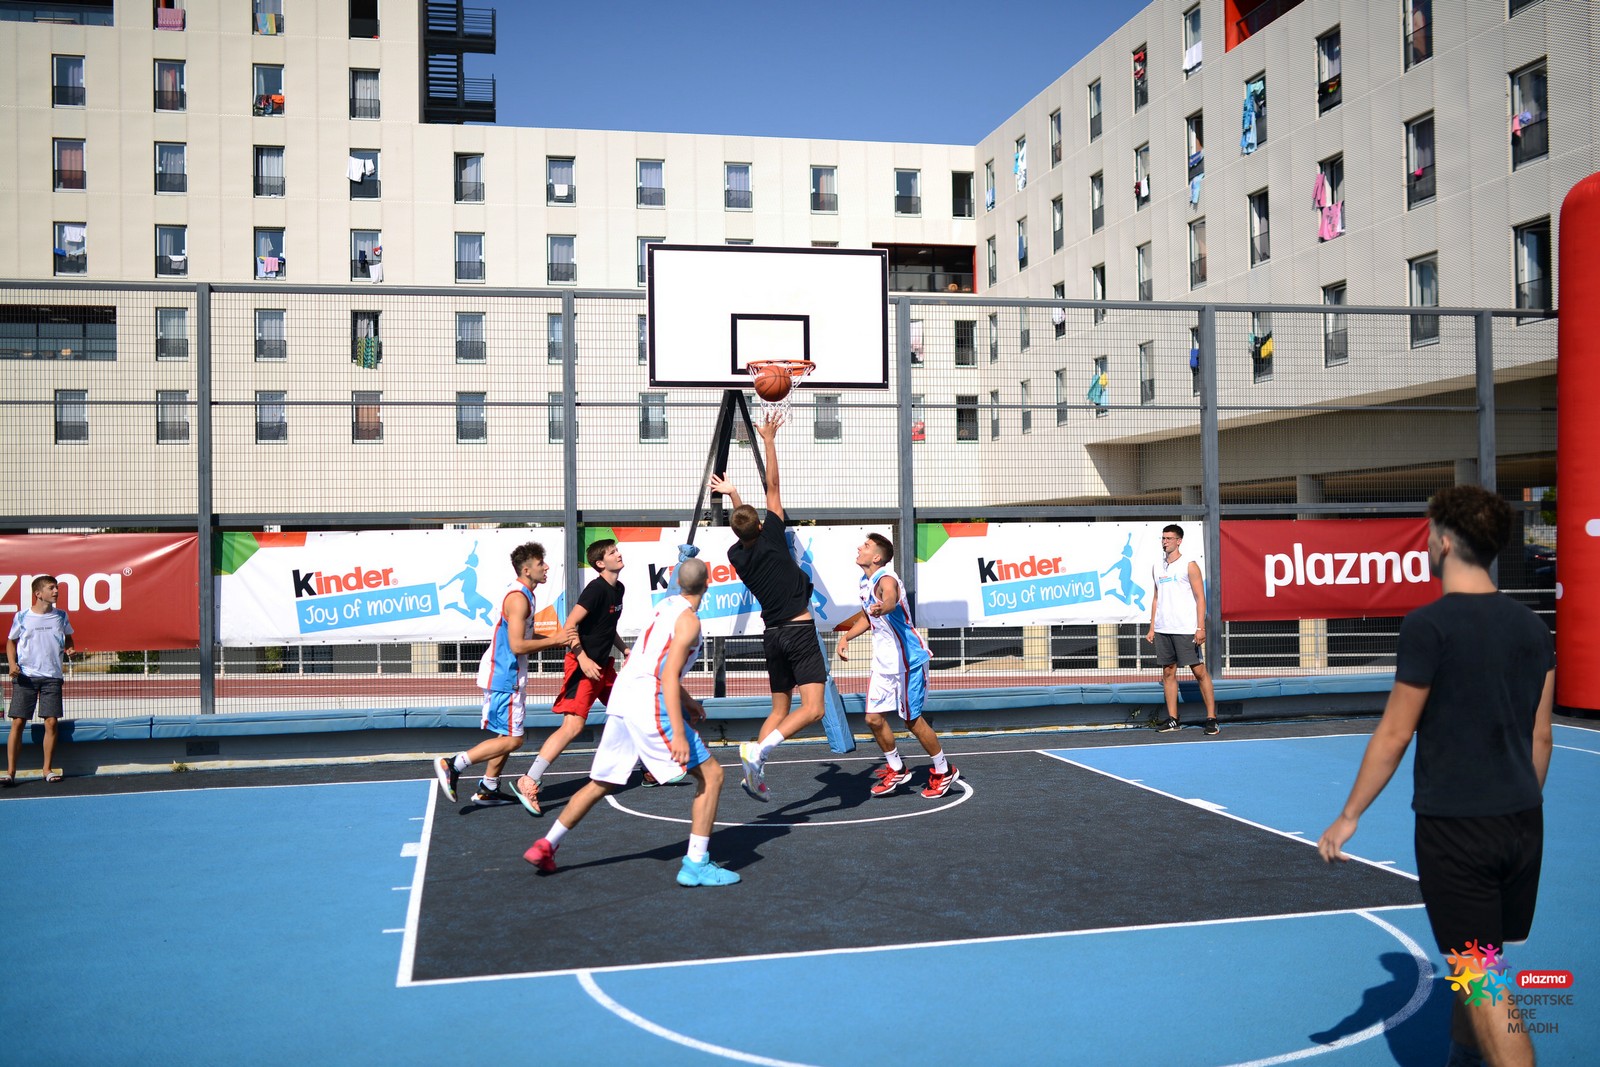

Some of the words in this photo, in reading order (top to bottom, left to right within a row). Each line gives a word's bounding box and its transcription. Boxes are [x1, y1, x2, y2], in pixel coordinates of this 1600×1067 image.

[292, 566, 395, 598] kinder
[978, 555, 1063, 584] kinder
[1265, 543, 1431, 598] plazma
[304, 605, 339, 626] Joy
[343, 598, 362, 619] of
[366, 592, 432, 617] moving
[988, 590, 1017, 609] Joy
[1020, 584, 1036, 604] of
[1040, 579, 1095, 601] moving
